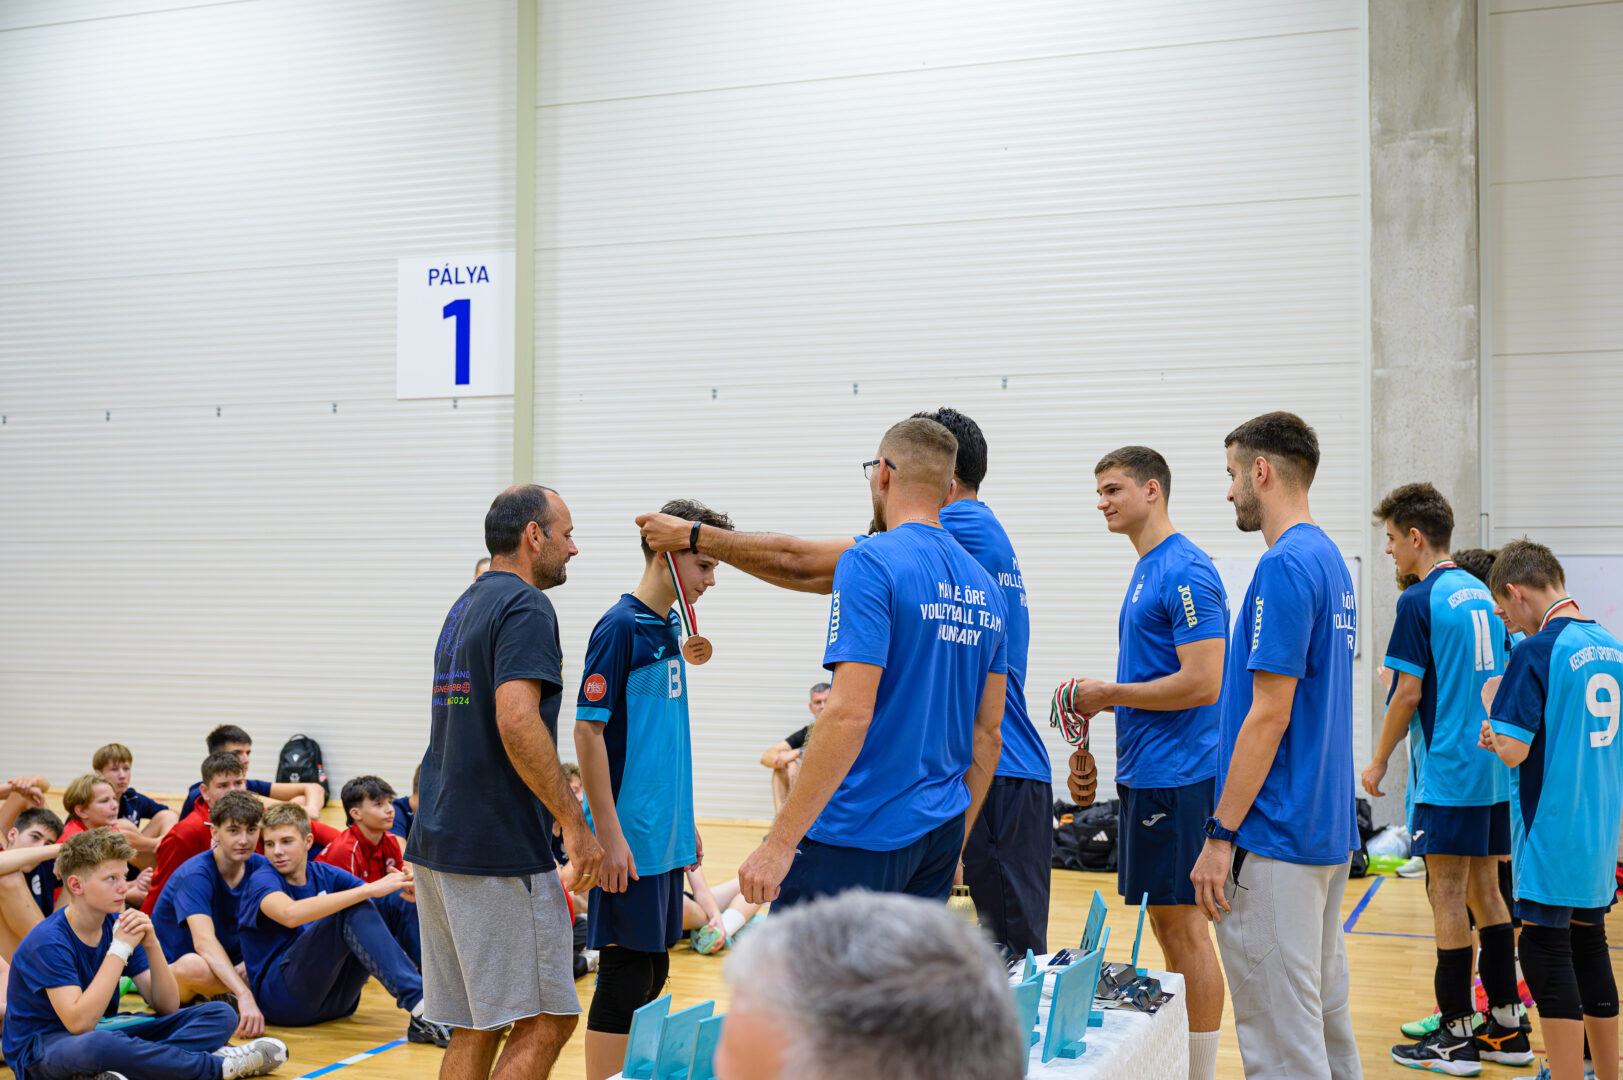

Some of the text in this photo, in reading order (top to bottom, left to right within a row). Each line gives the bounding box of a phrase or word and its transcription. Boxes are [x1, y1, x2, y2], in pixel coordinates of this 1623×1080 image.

[428, 262, 490, 286] PÁLYA
[443, 298, 471, 386] 1
[978, 610, 1002, 633] TEAM
[1470, 609, 1495, 672] 11
[1585, 672, 1621, 748] 9
